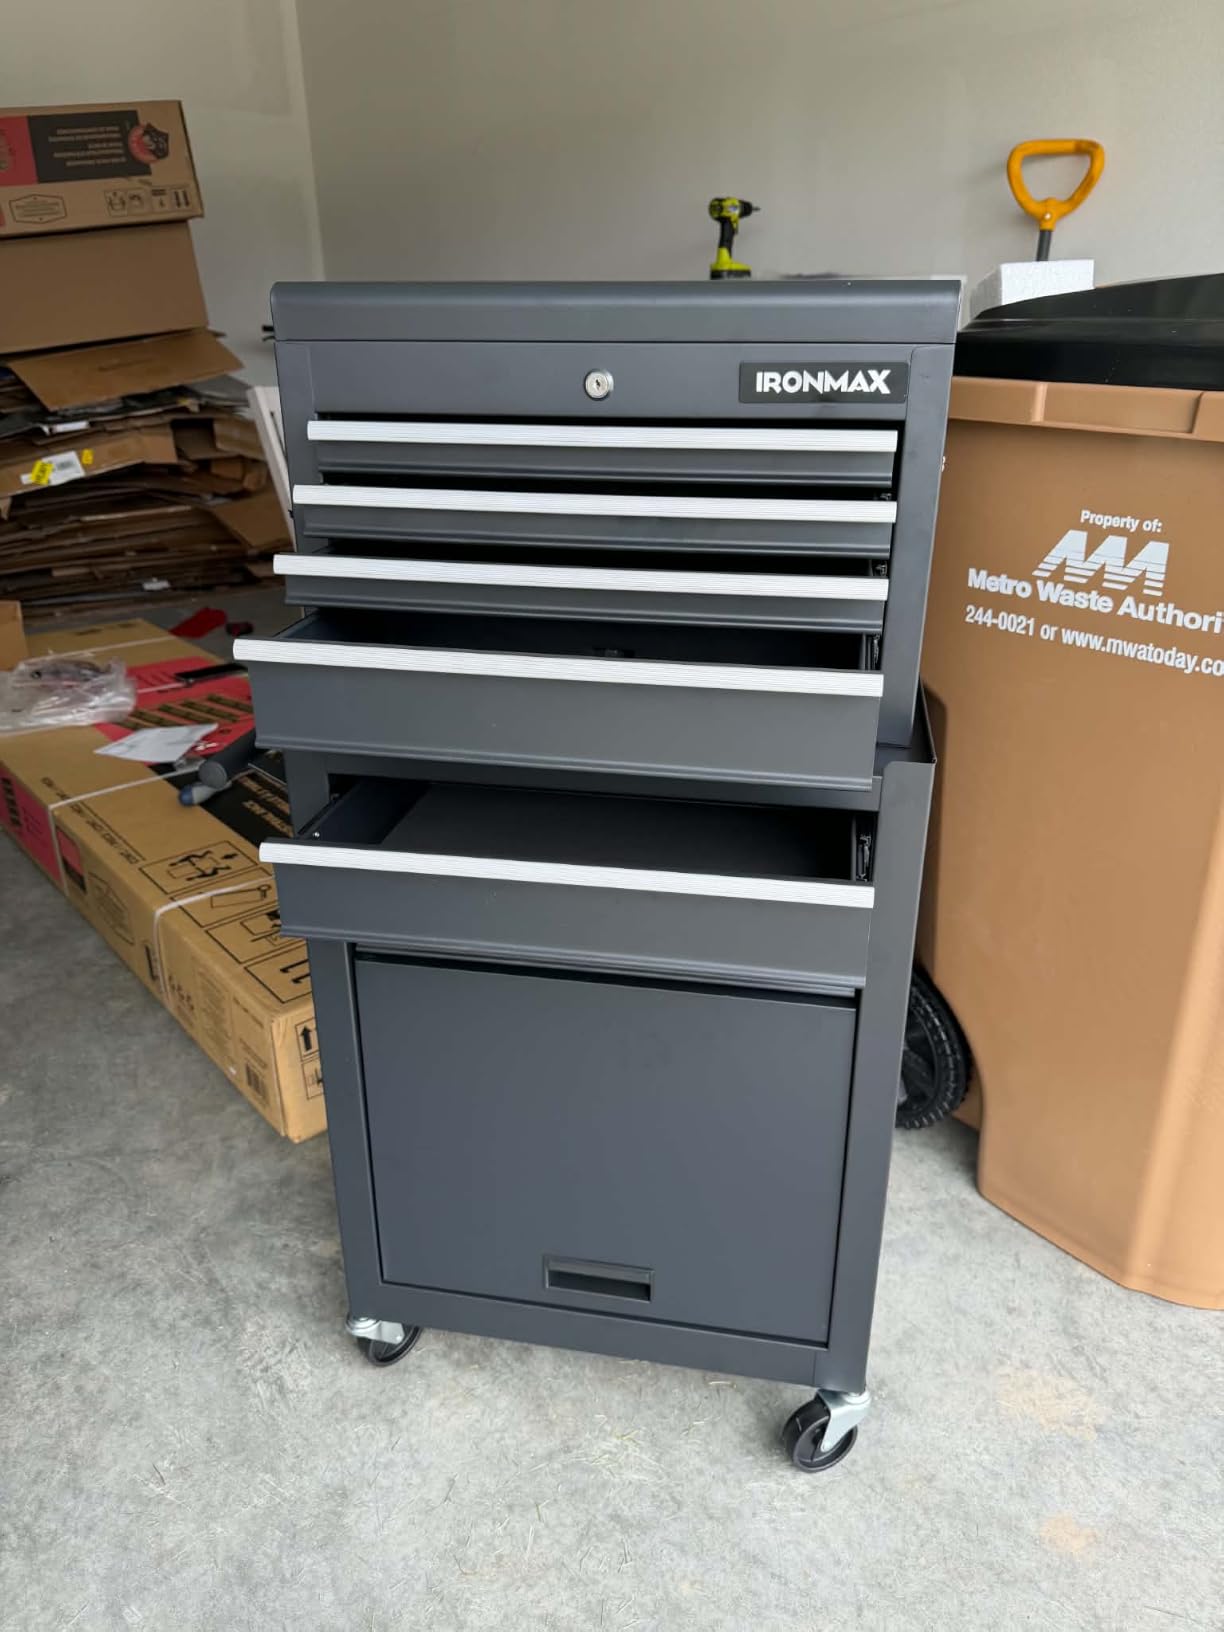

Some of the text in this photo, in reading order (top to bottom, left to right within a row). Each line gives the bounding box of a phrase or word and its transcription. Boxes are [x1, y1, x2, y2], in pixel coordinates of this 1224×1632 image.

[756, 370, 891, 394] IRONMAX
[1081, 509, 1162, 532] Property of:
[968, 568, 1032, 598] Metro
[1036, 580, 1113, 613] Waste
[965, 605, 1035, 636] 244-0021
[1041, 624, 1057, 640] or
